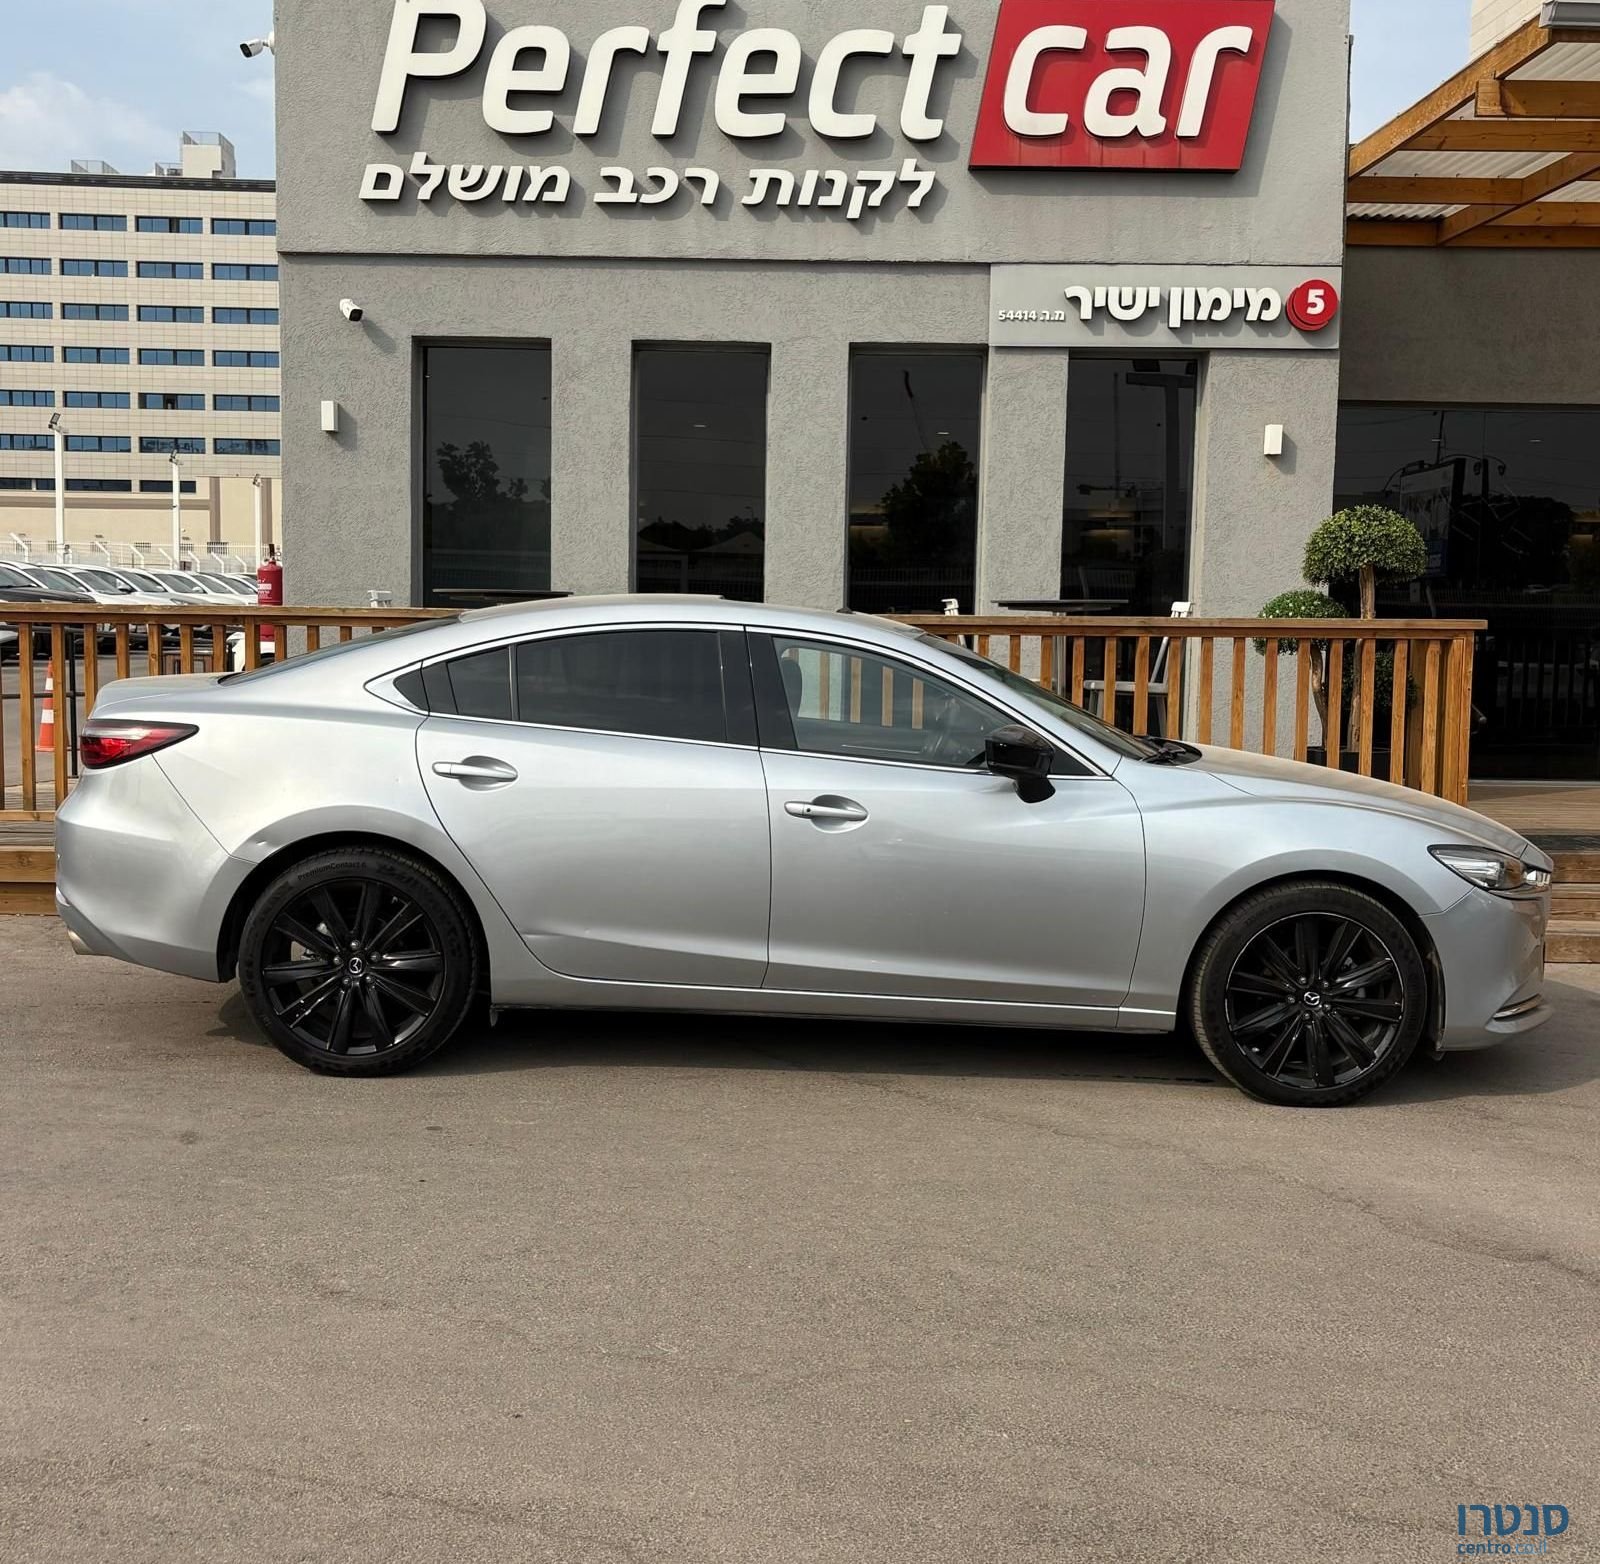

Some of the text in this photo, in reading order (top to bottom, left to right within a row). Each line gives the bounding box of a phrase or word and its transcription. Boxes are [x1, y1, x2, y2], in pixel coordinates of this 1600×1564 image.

[371, 0, 1253, 141] Perfect car
[358, 152, 936, 220] לקנות רכב מושלם
[997, 309, 1037, 321] 54414
[1063, 285, 1326, 329] 5 מימון ישיר
